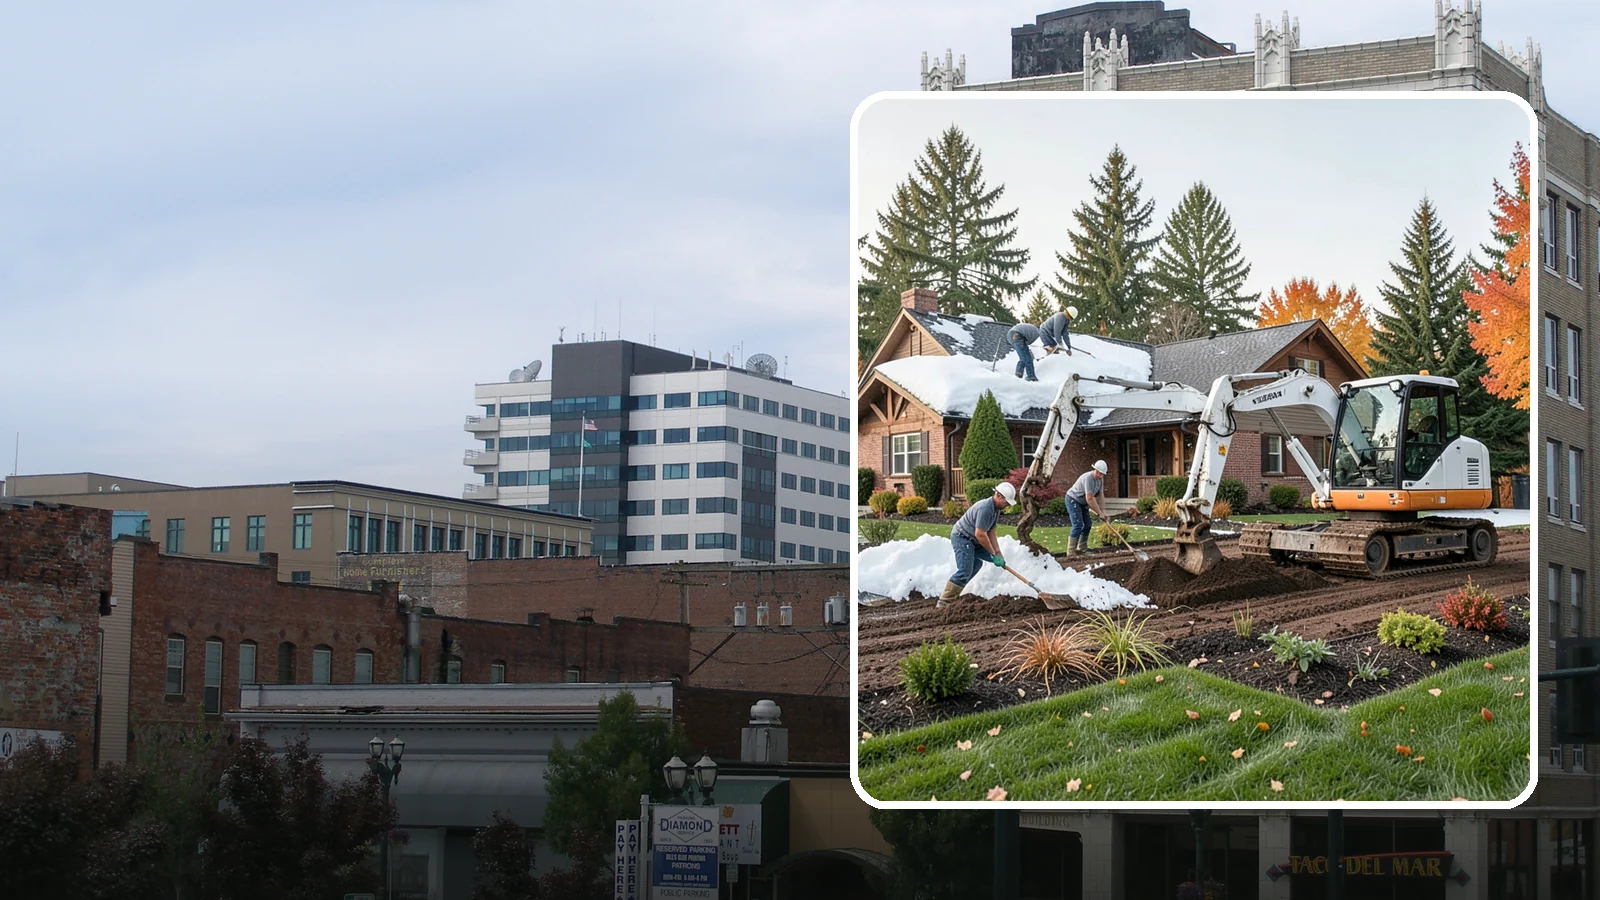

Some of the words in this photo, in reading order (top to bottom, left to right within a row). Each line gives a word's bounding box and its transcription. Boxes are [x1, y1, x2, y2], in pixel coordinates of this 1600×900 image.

[370, 566, 427, 576] Furnishers
[660, 818, 713, 832] DIAMOND
[1022, 815, 1070, 828] BUILDING
[617, 824, 625, 852] PAY
[628, 824, 637, 852] PAY
[656, 845, 688, 853] RESERVED
[689, 846, 716, 854] PARKING
[721, 852, 739, 862] Soup
[671, 862, 701, 870] PATRONS
[1345, 857, 1385, 876] DEL
[1392, 857, 1443, 877] MAR
[617, 856, 625, 893] HERE
[628, 855, 636, 893] HERE
[660, 888, 682, 897] PUBLIC
[683, 889, 710, 898] PARKING
